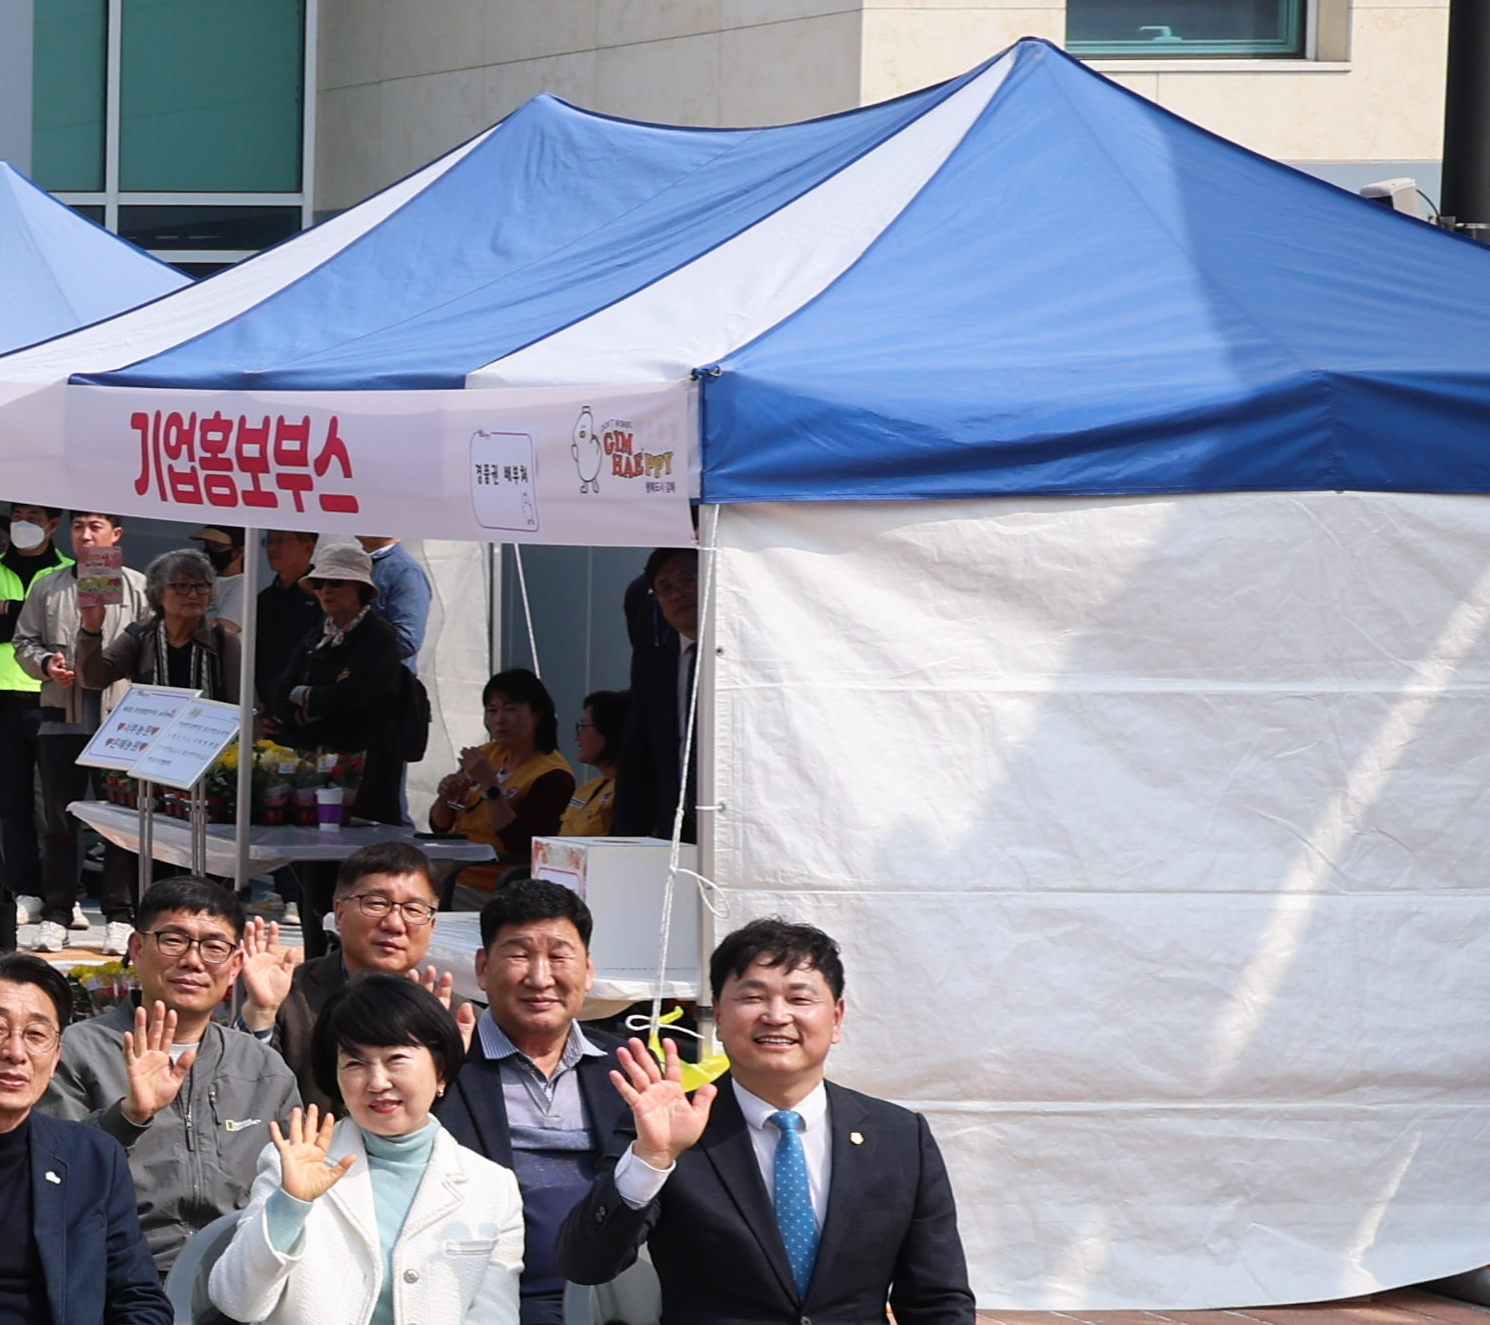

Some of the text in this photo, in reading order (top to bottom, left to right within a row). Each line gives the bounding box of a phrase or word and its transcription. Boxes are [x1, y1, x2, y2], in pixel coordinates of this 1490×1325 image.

[603, 430, 634, 456] GIM
[130, 408, 360, 514] 기업홍보부스
[475, 464, 499, 486] 경품권
